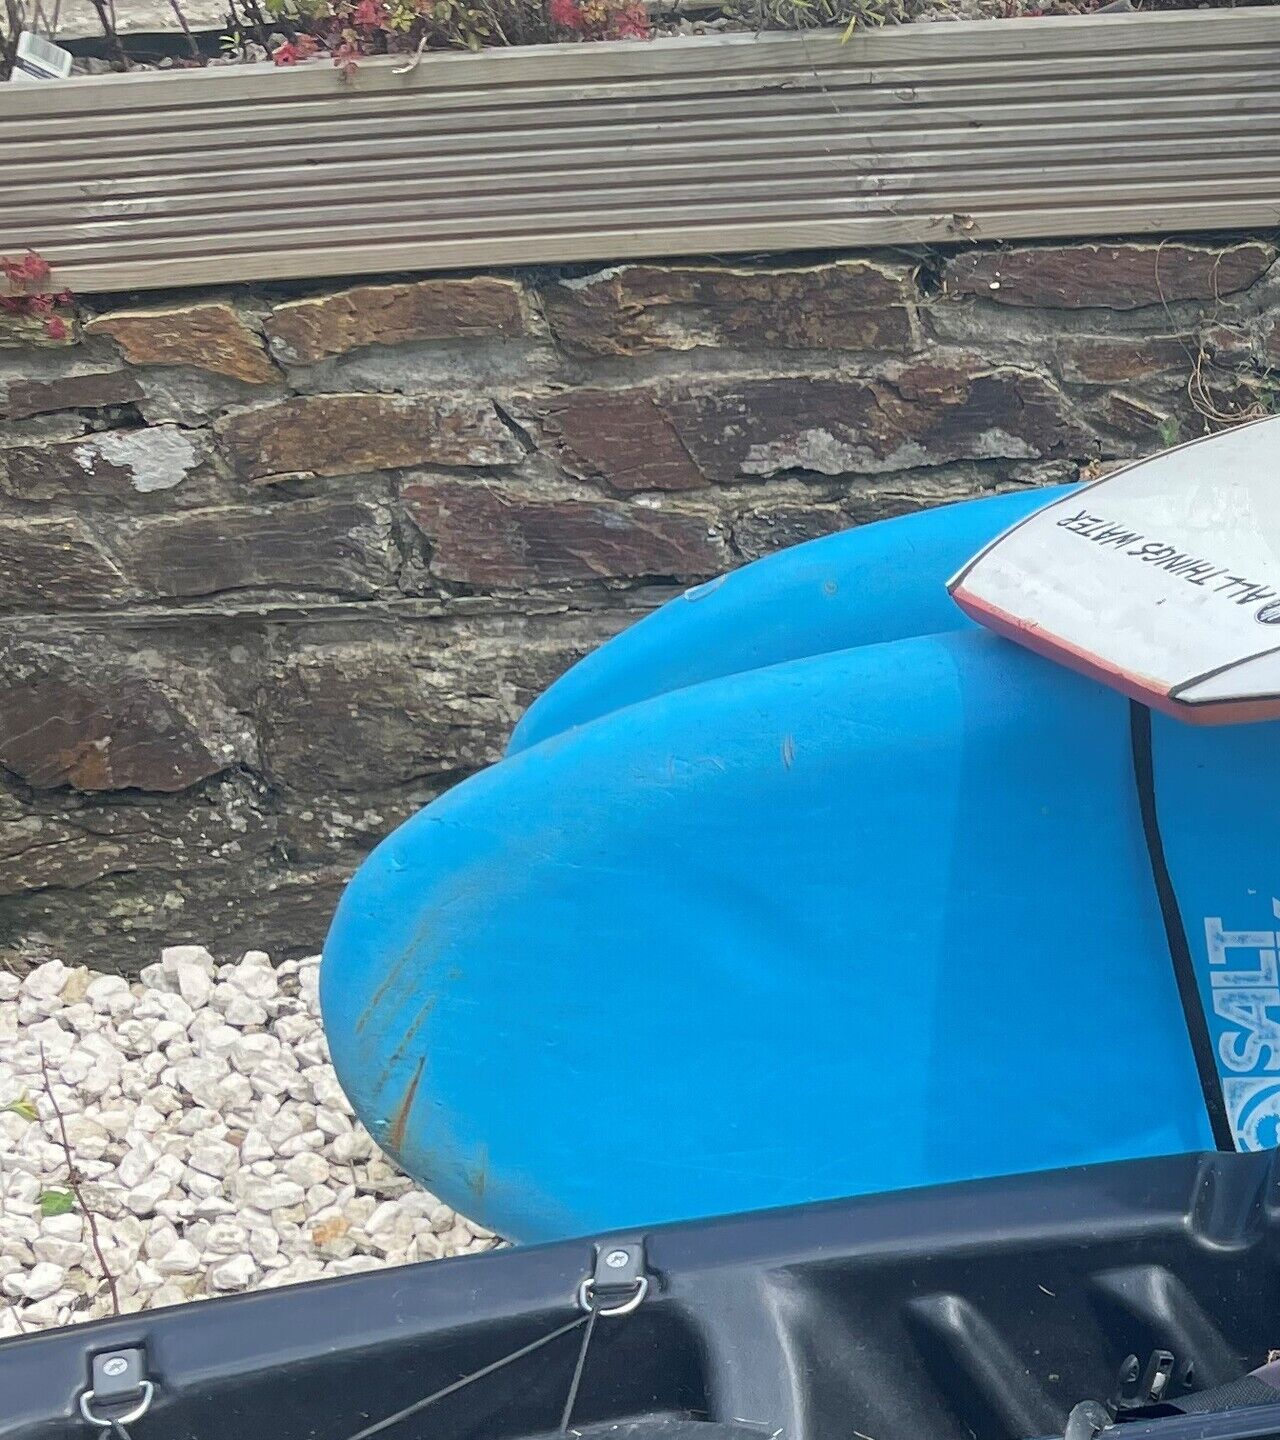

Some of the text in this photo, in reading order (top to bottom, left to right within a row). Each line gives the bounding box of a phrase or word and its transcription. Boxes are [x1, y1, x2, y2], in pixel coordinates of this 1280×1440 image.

[1055, 509, 1277, 606] ALL THINGS WATER
